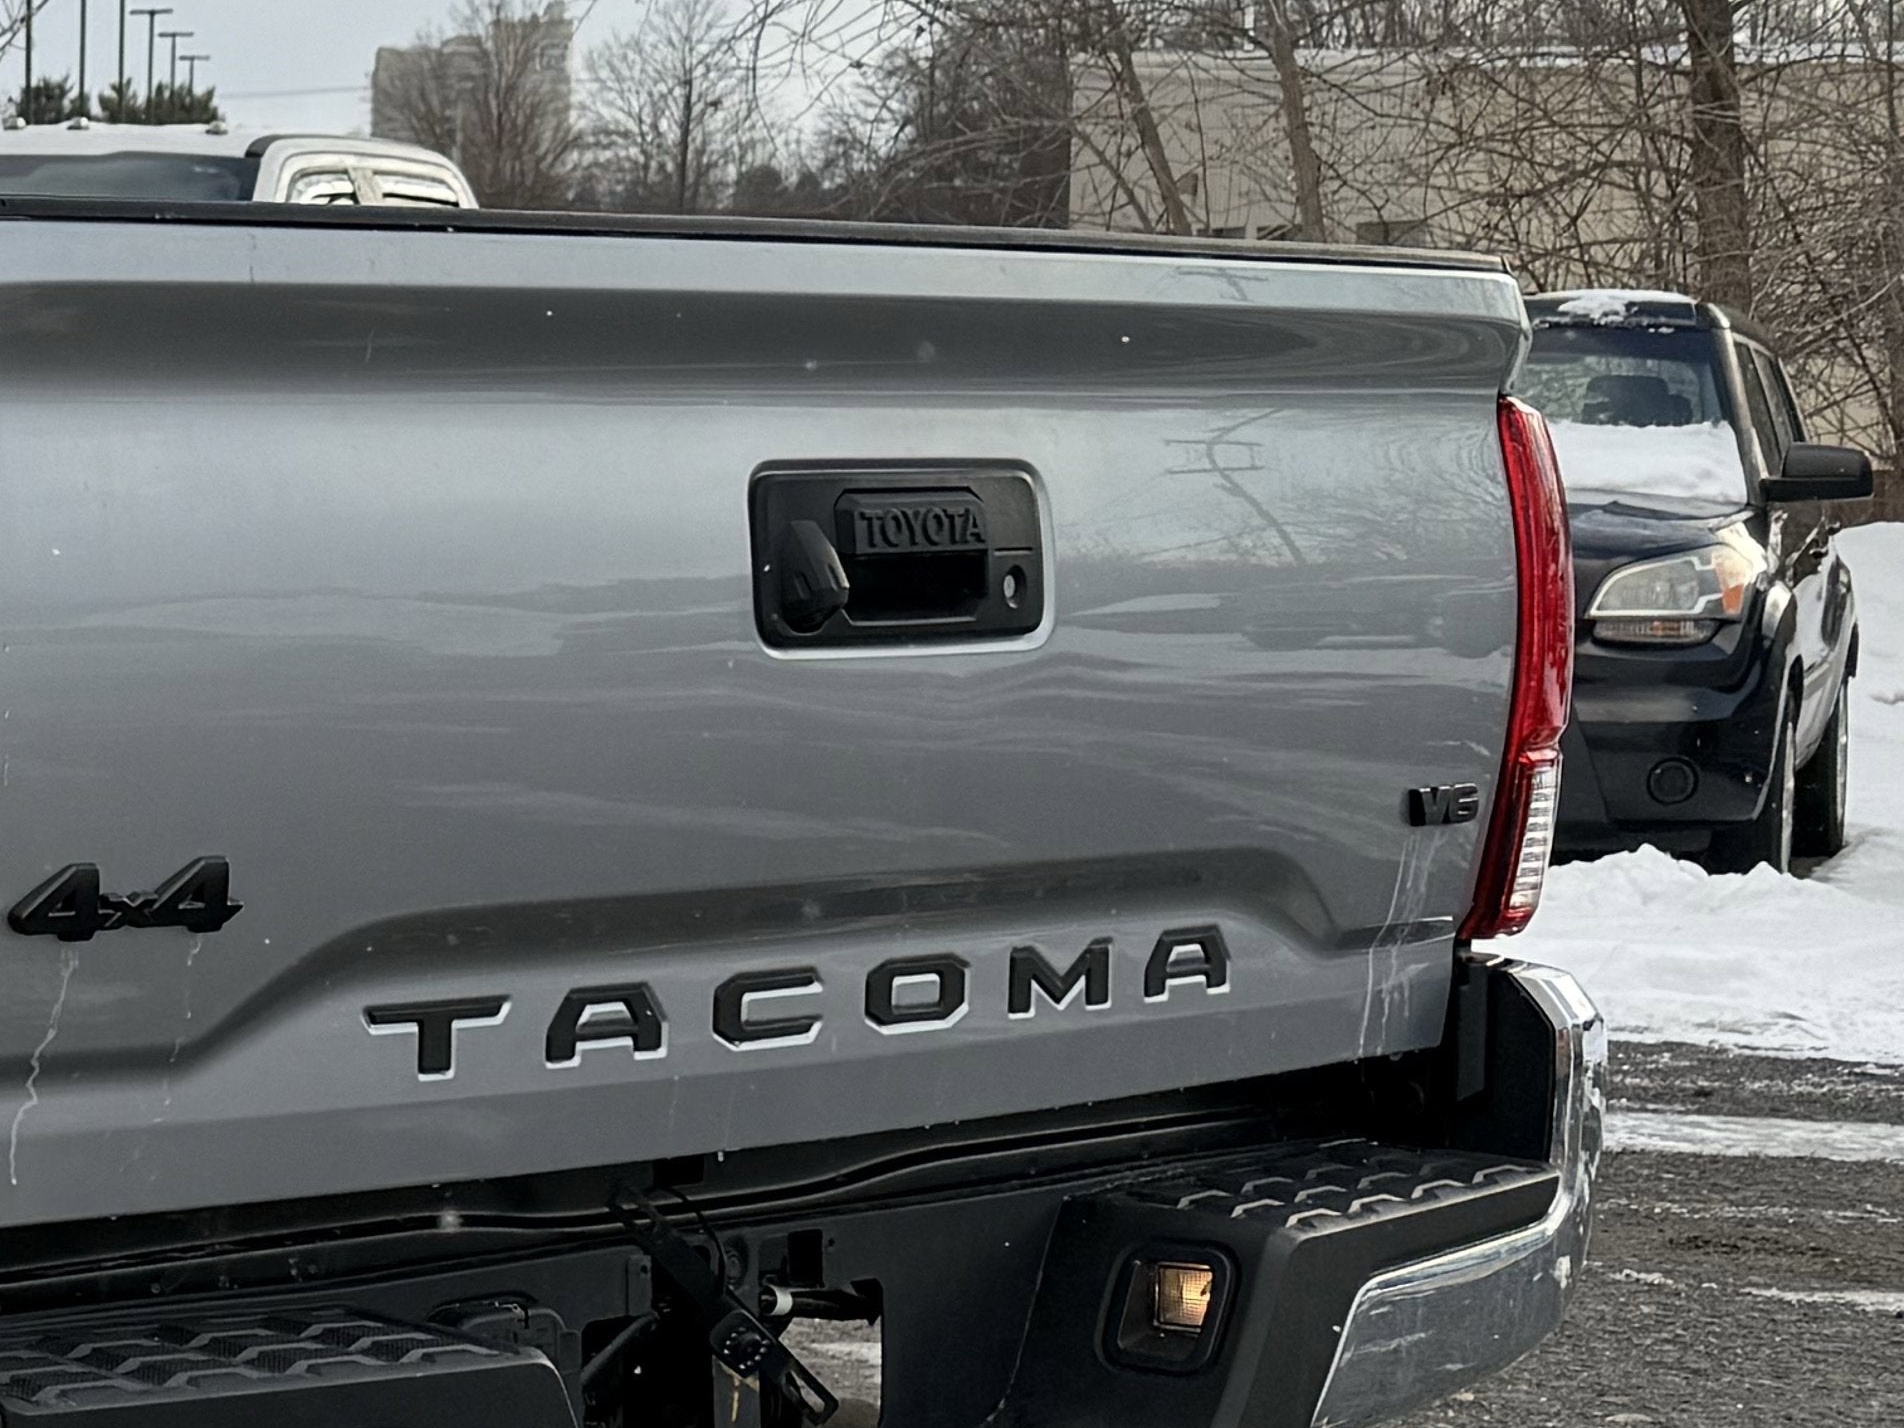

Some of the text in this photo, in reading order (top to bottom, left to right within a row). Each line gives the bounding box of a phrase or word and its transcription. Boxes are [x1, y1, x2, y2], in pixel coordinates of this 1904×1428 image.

[861, 507, 986, 549] TOYOTA
[1408, 783, 1479, 827] V6
[362, 922, 1231, 1083] TACOMA
